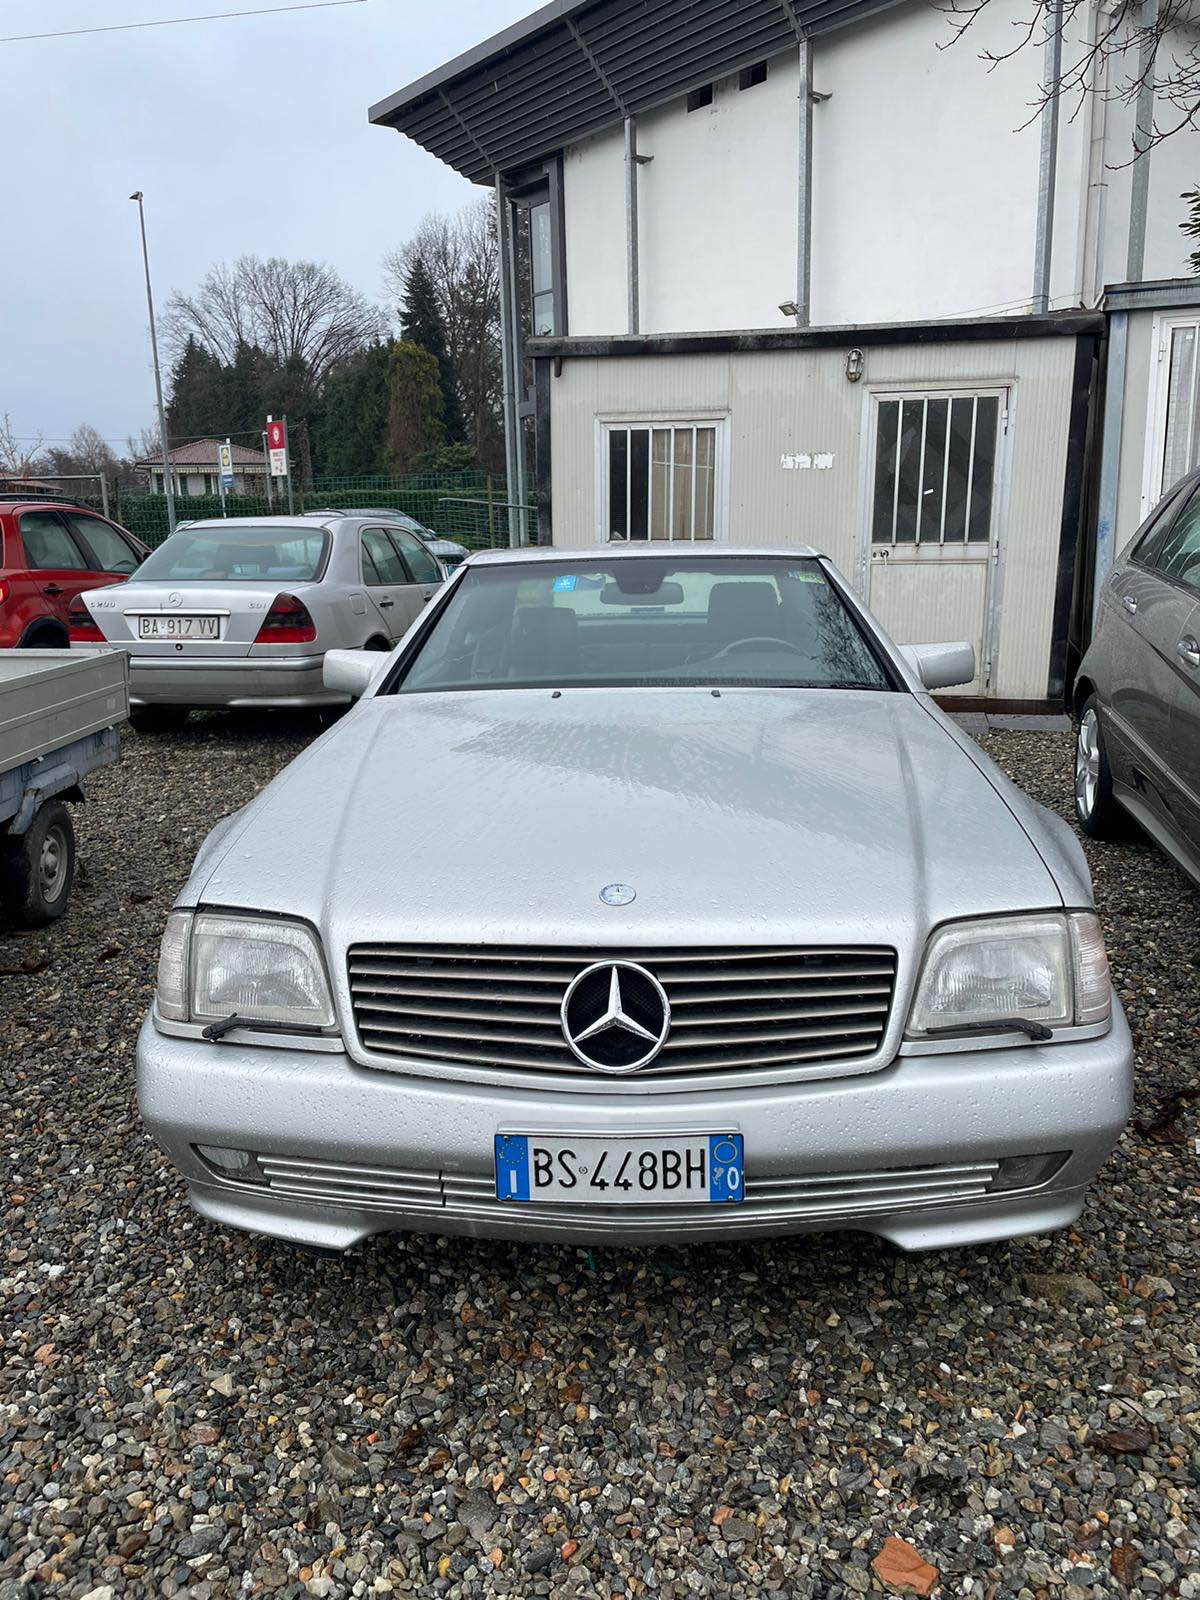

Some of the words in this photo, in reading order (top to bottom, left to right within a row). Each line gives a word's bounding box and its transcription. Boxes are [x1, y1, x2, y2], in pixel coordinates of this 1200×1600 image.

[142, 618, 159, 634] BA
[167, 618, 193, 634] 917
[510, 1169, 518, 1193] I
